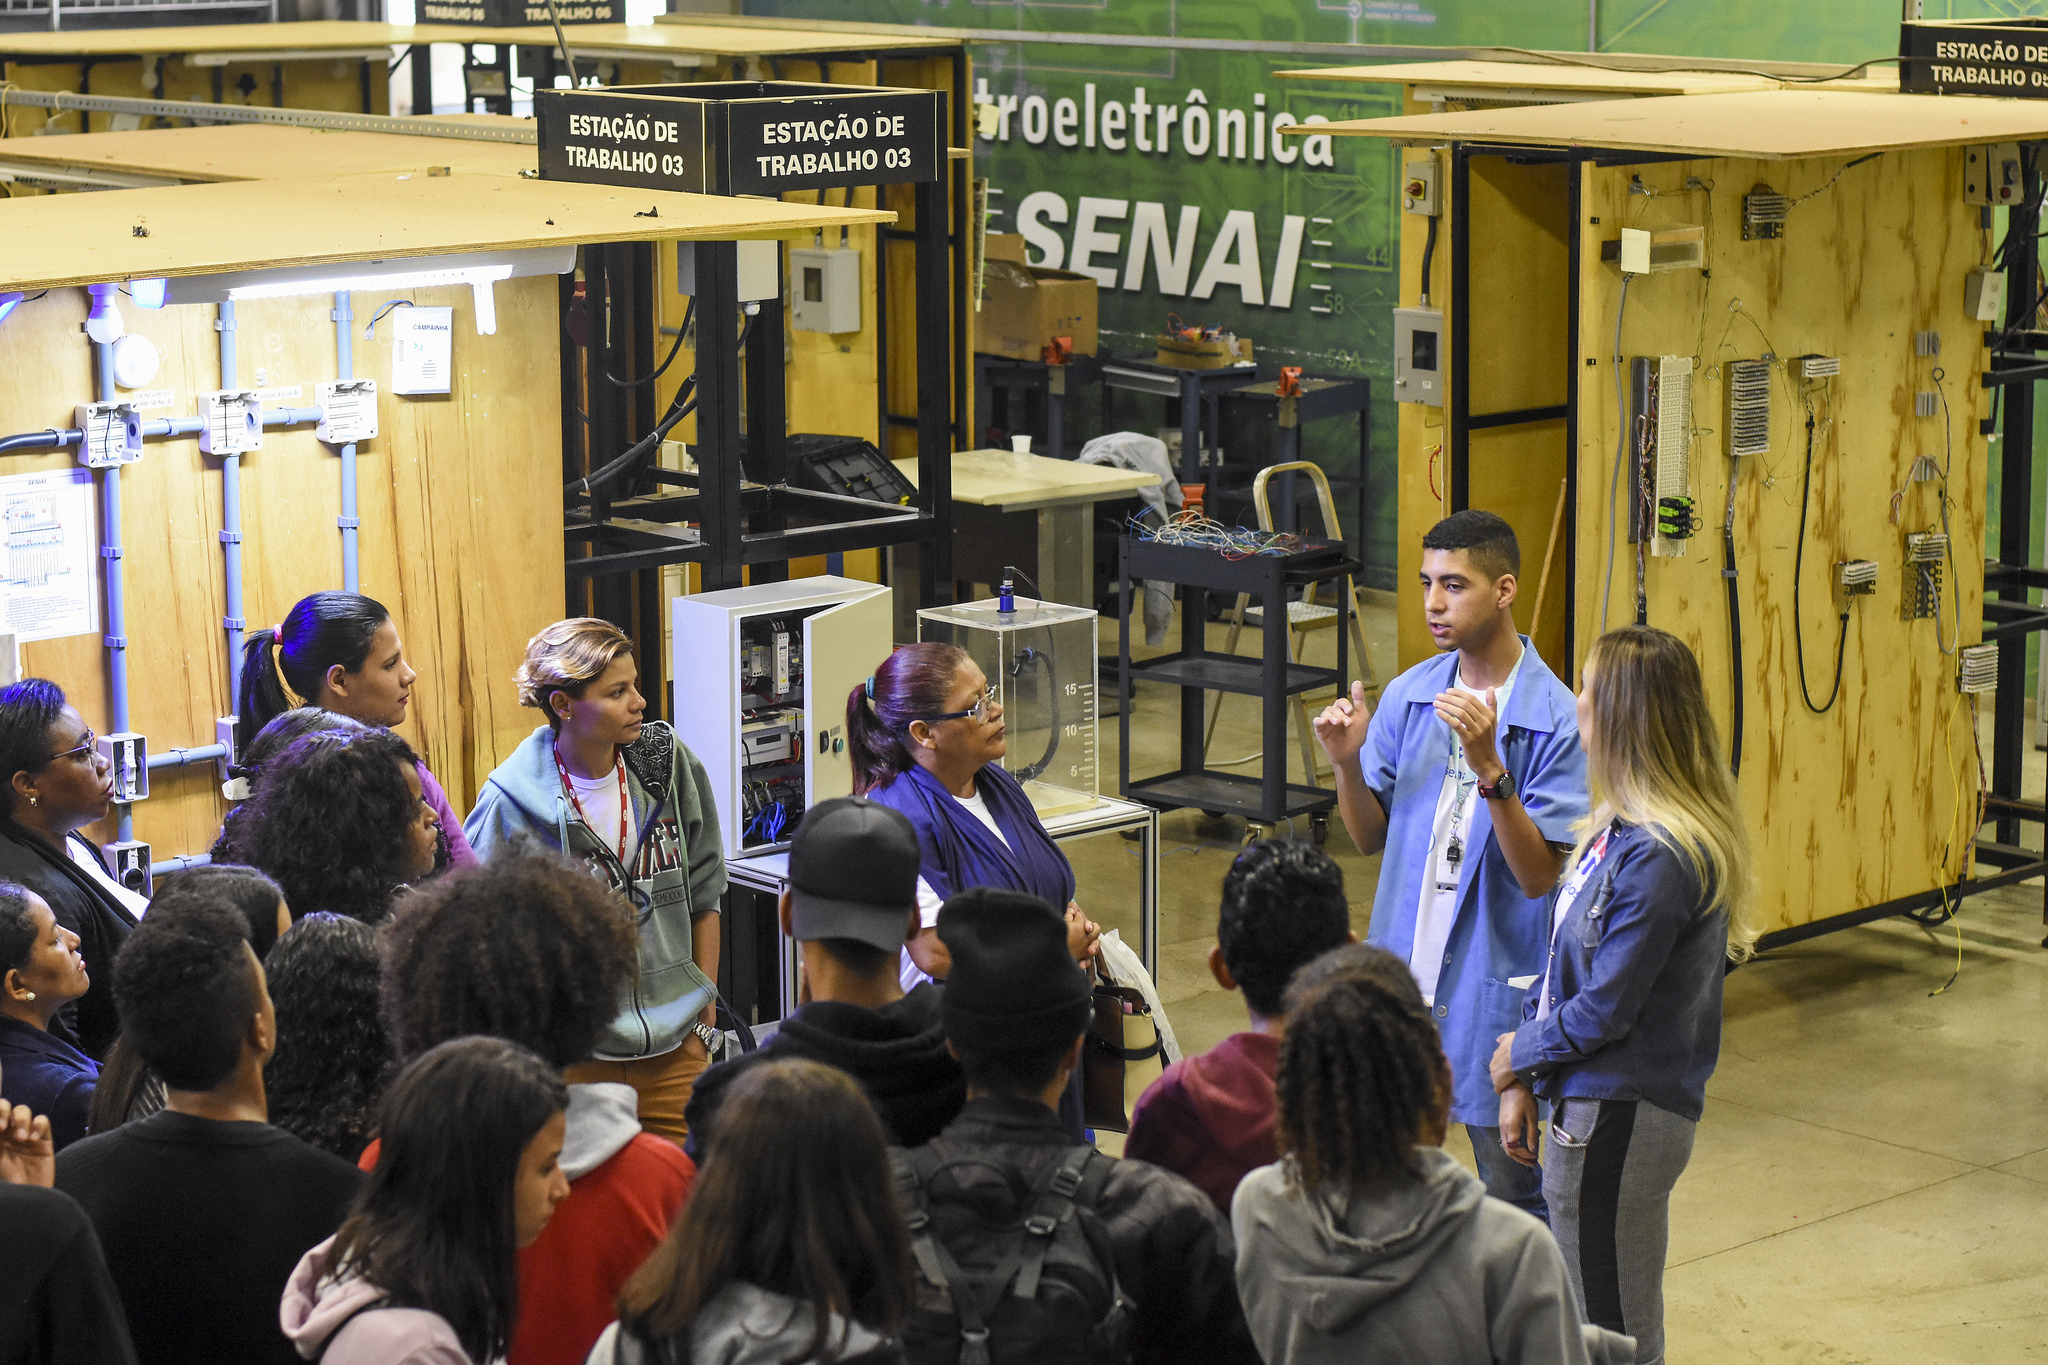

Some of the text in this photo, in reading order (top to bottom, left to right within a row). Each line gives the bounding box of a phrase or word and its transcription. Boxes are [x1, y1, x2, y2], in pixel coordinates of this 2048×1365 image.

[524, 6, 593, 21] TRAALHO
[1936, 40, 2048, 63] ESTAÇÃO DE
[1930, 65, 2027, 86] TRABALHO
[569, 113, 679, 144] ESTAÇÃO DE
[763, 113, 905, 146] ESTAÇÃO DE
[565, 146, 684, 176] TRABALHO 03
[756, 147, 911, 177] TRABALHO 03
[1016, 191, 1306, 309] SENAI
[1323, 293, 1345, 315] 58
[1064, 683, 1077, 696] 15
[1064, 724, 1077, 737] 10
[1070, 765, 1078, 777] 5
